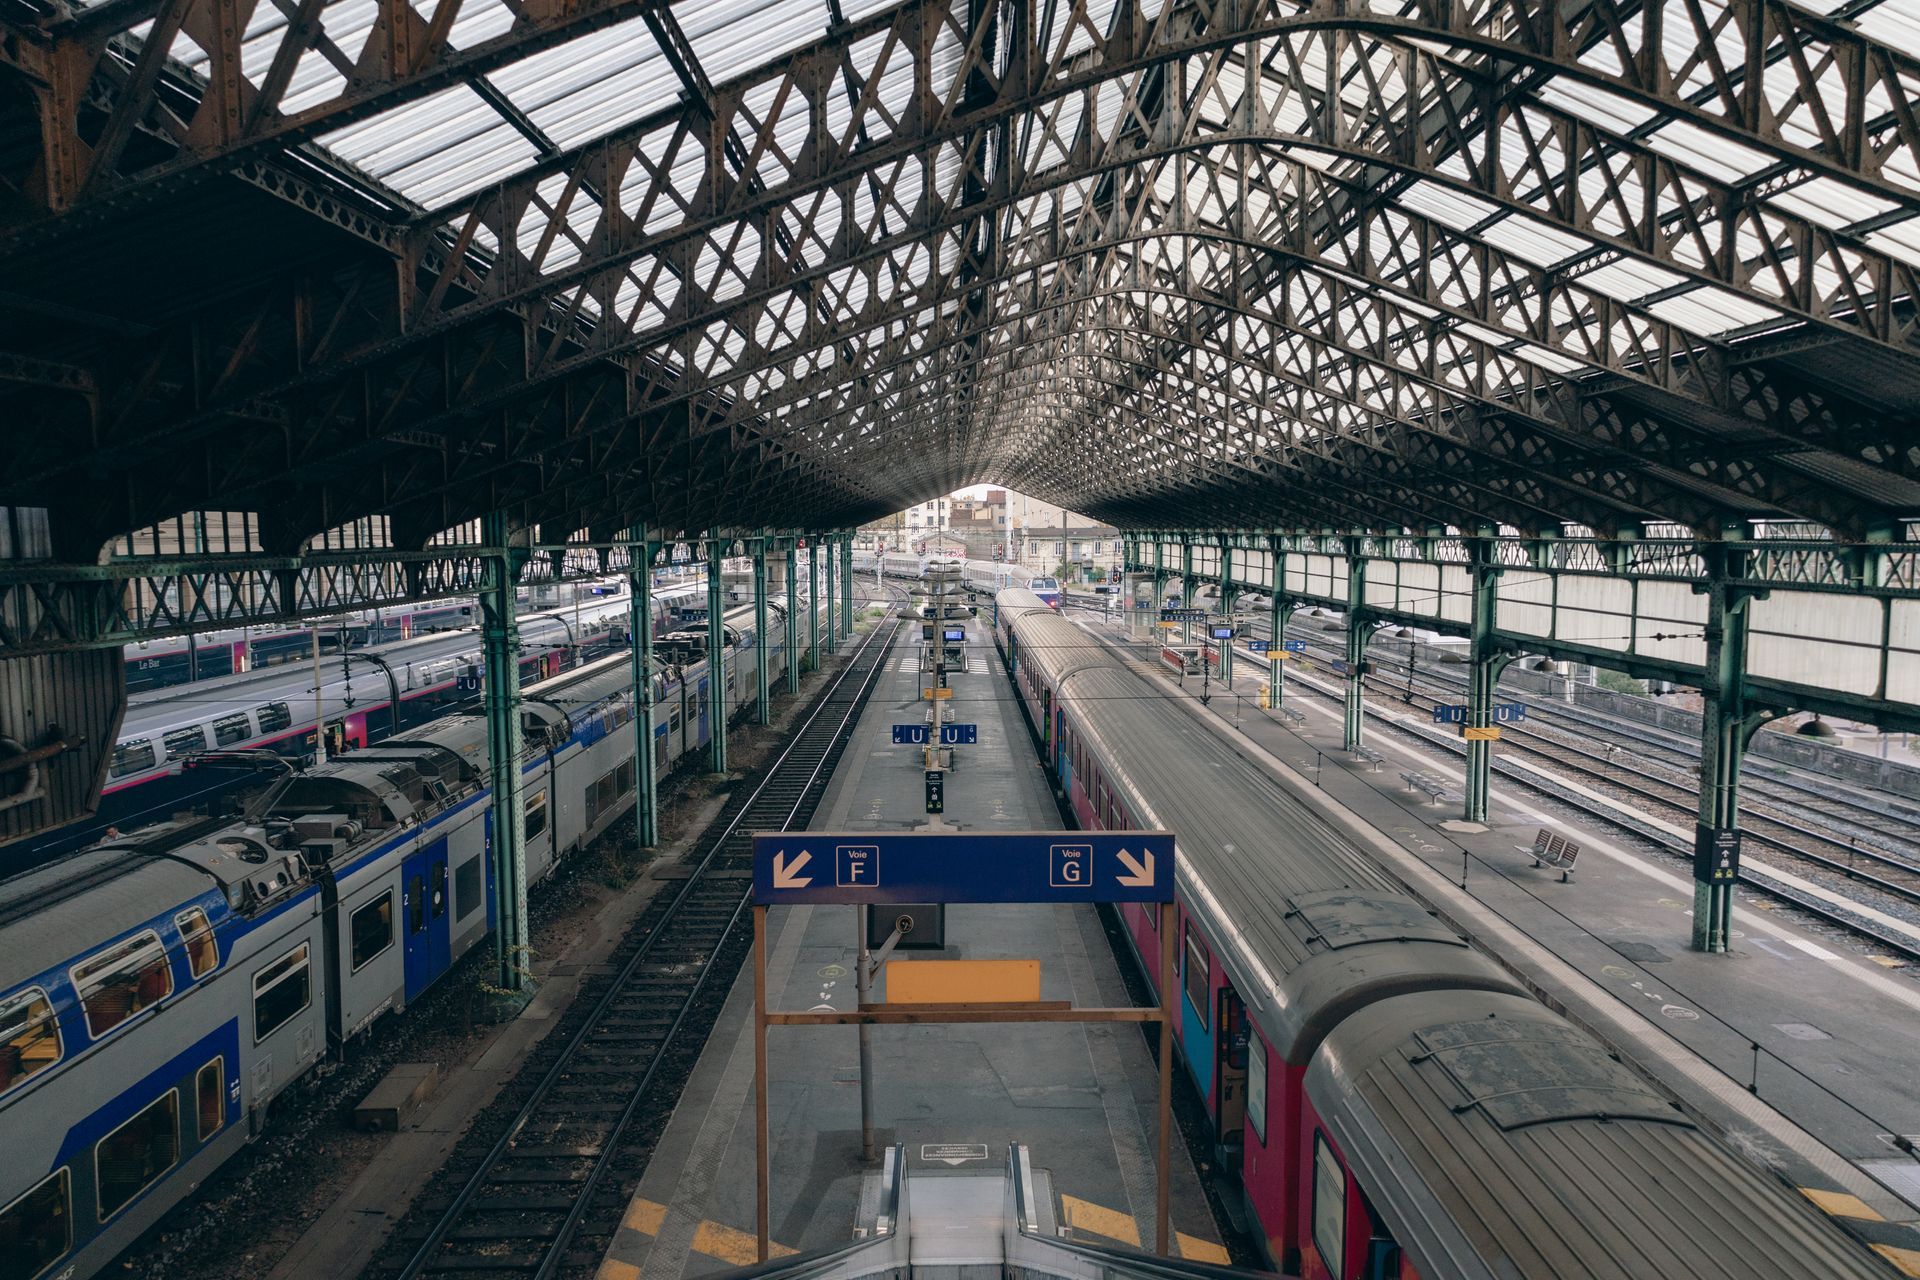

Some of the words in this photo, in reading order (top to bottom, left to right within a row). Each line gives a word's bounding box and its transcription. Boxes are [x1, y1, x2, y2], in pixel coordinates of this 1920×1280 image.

[139, 661, 148, 670] Le
[148, 659, 160, 668] Bar
[467, 679, 476, 690] U
[1451, 709, 1462, 722] U
[1498, 708, 1509, 721] U
[911, 729, 923, 743] U
[946, 729, 958, 743] U
[848, 850, 868, 859] Voie
[1062, 849, 1081, 858] Voie
[443, 866, 449, 879] 2
[850, 862, 865, 882] F
[1062, 861, 1081, 882] G
[403, 893, 409, 906] 2
